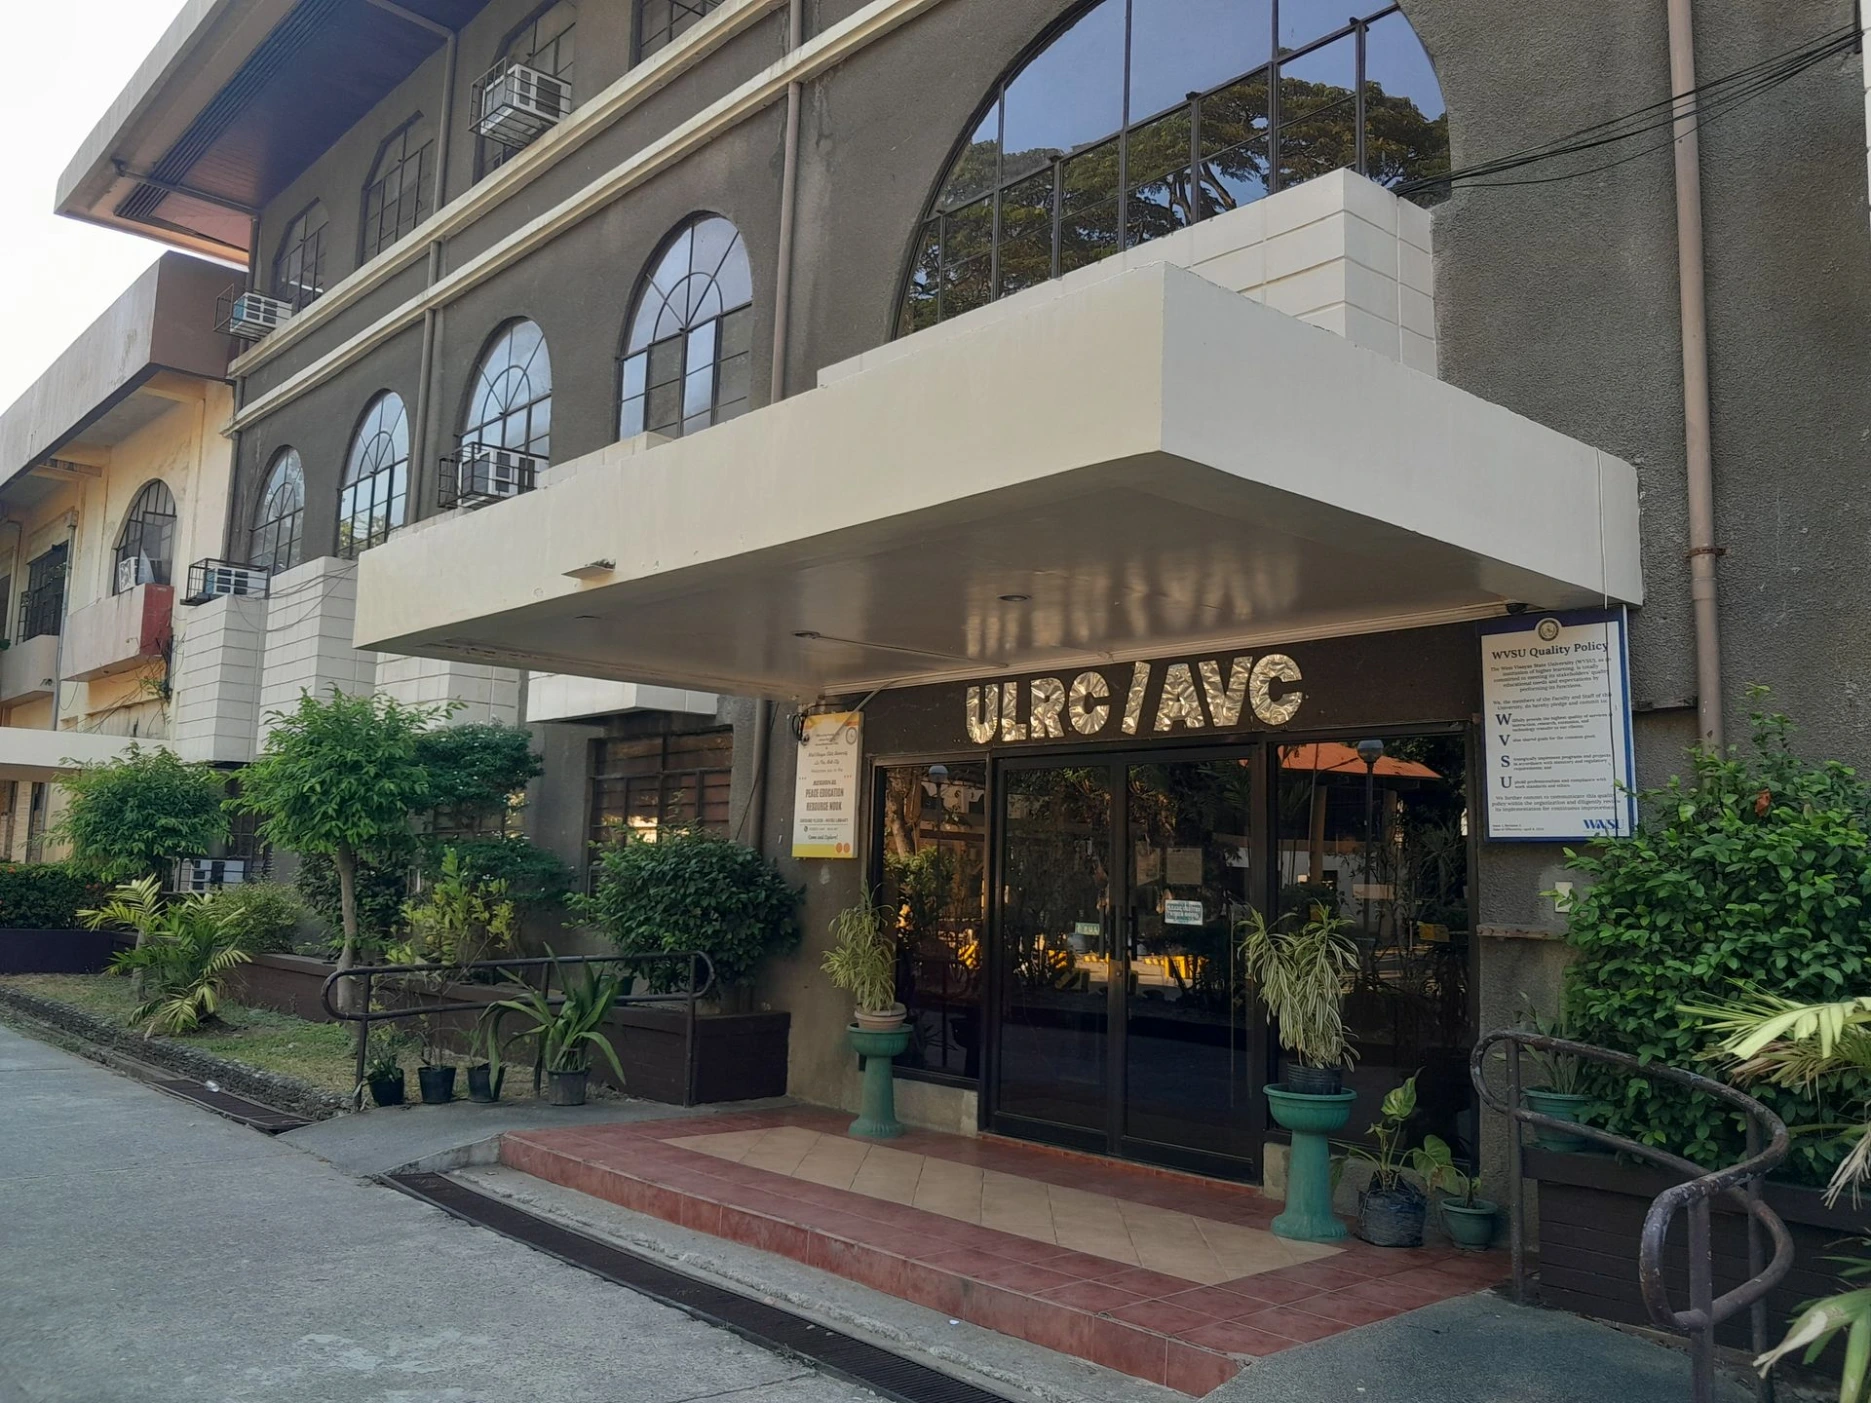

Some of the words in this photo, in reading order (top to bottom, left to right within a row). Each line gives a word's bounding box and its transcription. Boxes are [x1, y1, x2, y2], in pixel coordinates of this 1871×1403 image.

[1492, 649, 1526, 660] WVSU
[1530, 645, 1570, 657] Quality
[1574, 642, 1608, 652] Policy
[1496, 713, 1512, 726] W
[1499, 735, 1510, 746] V
[1501, 755, 1510, 767] S
[1500, 776, 1512, 788] U
